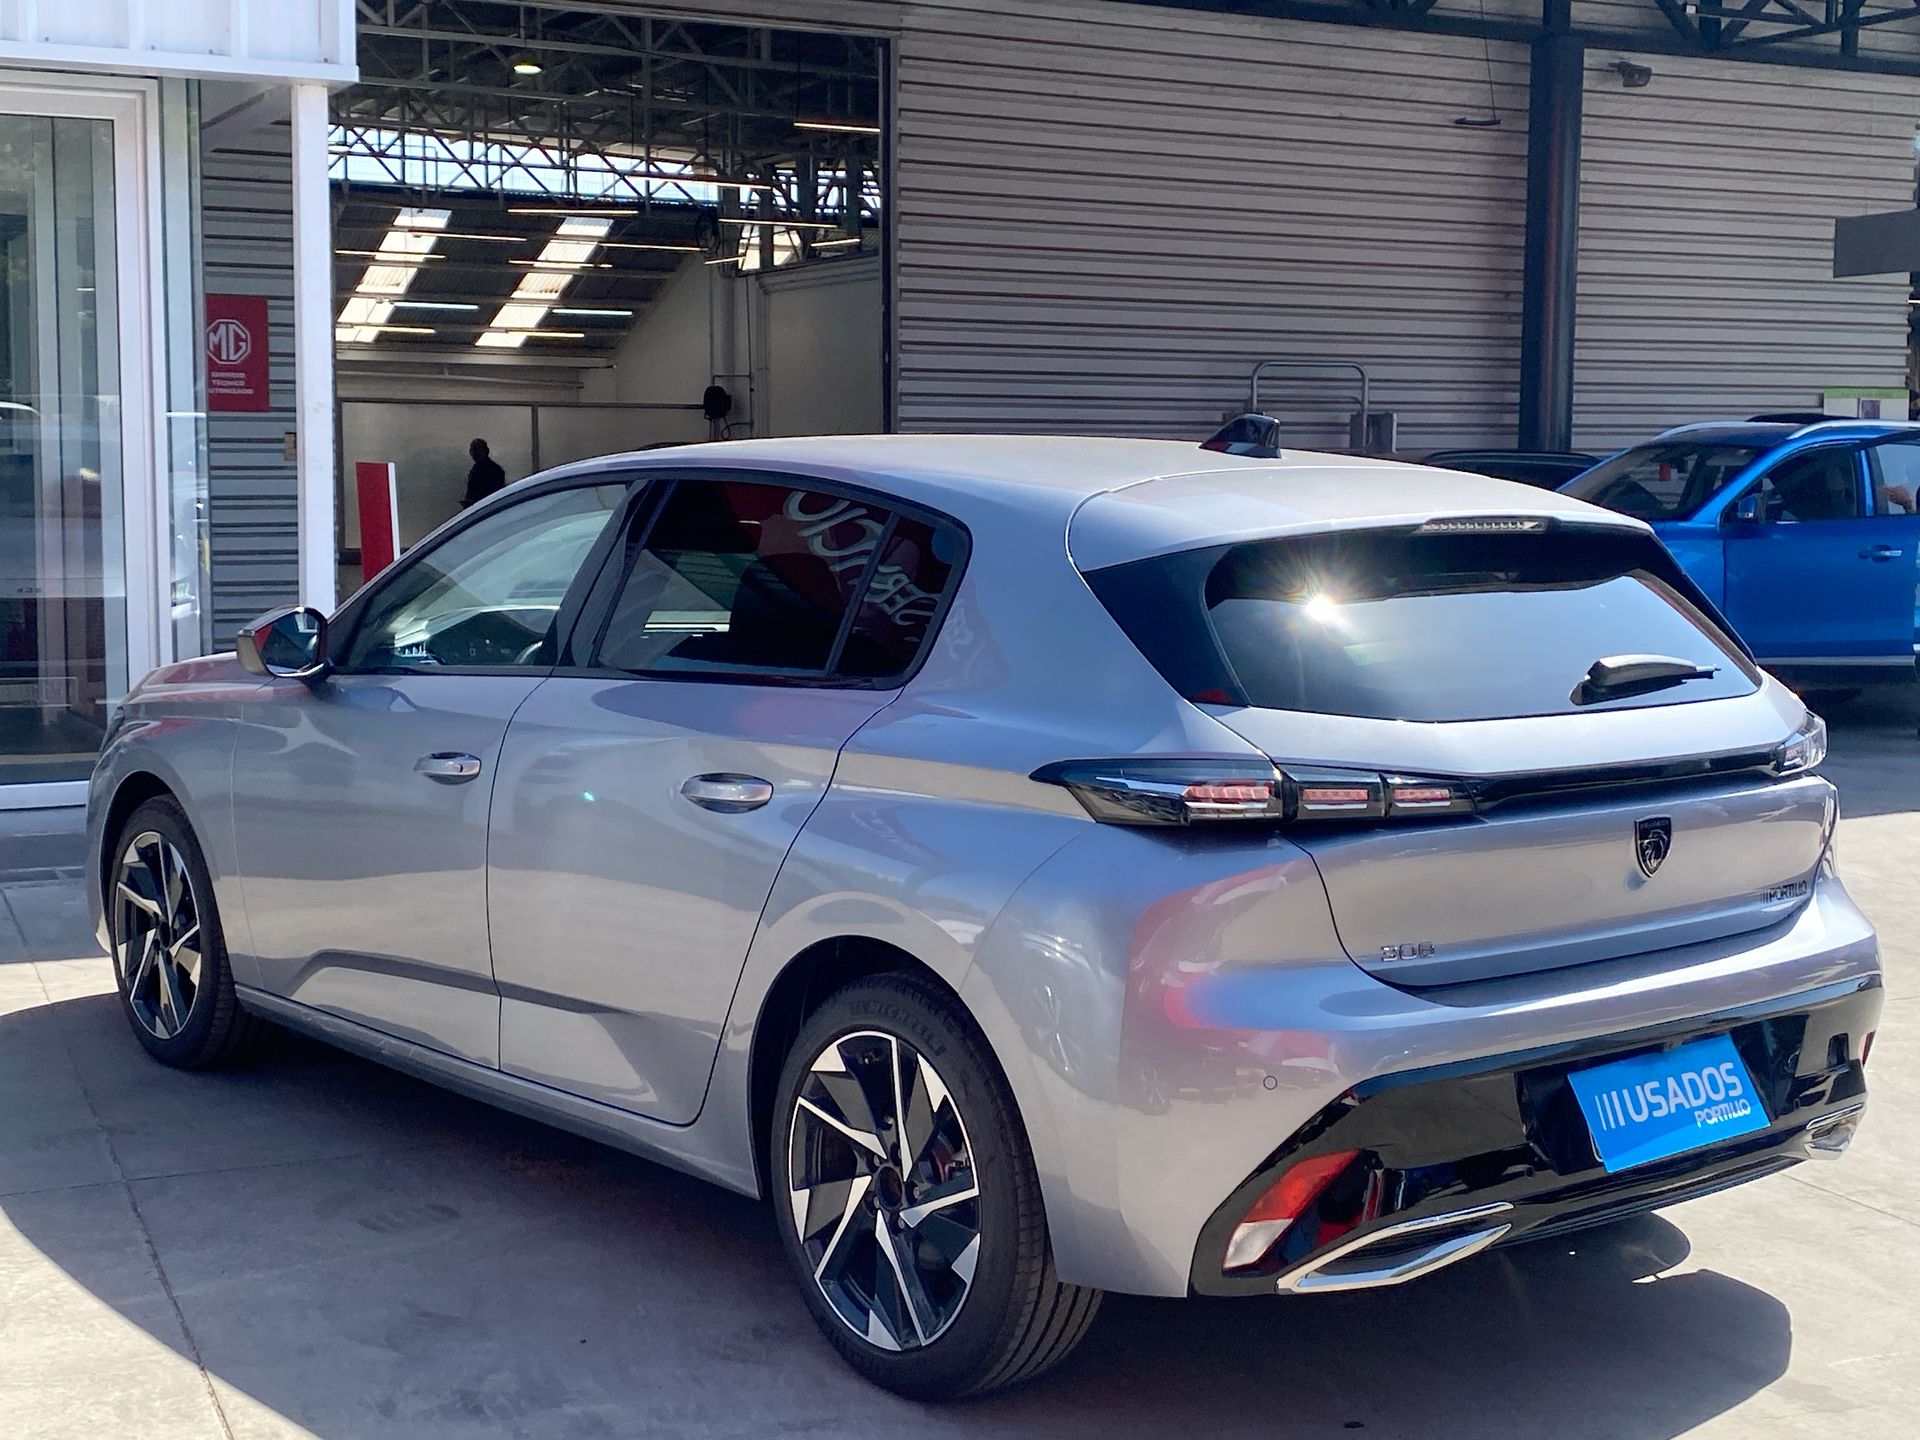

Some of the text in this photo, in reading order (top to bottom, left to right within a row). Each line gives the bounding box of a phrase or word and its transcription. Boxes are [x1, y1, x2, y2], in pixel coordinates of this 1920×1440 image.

[208, 322, 247, 360] MG
[208, 387, 254, 395] UTORIZADO
[1622, 1062, 1743, 1123] USADOS
[1694, 1098, 1751, 1128] PORTILLO
